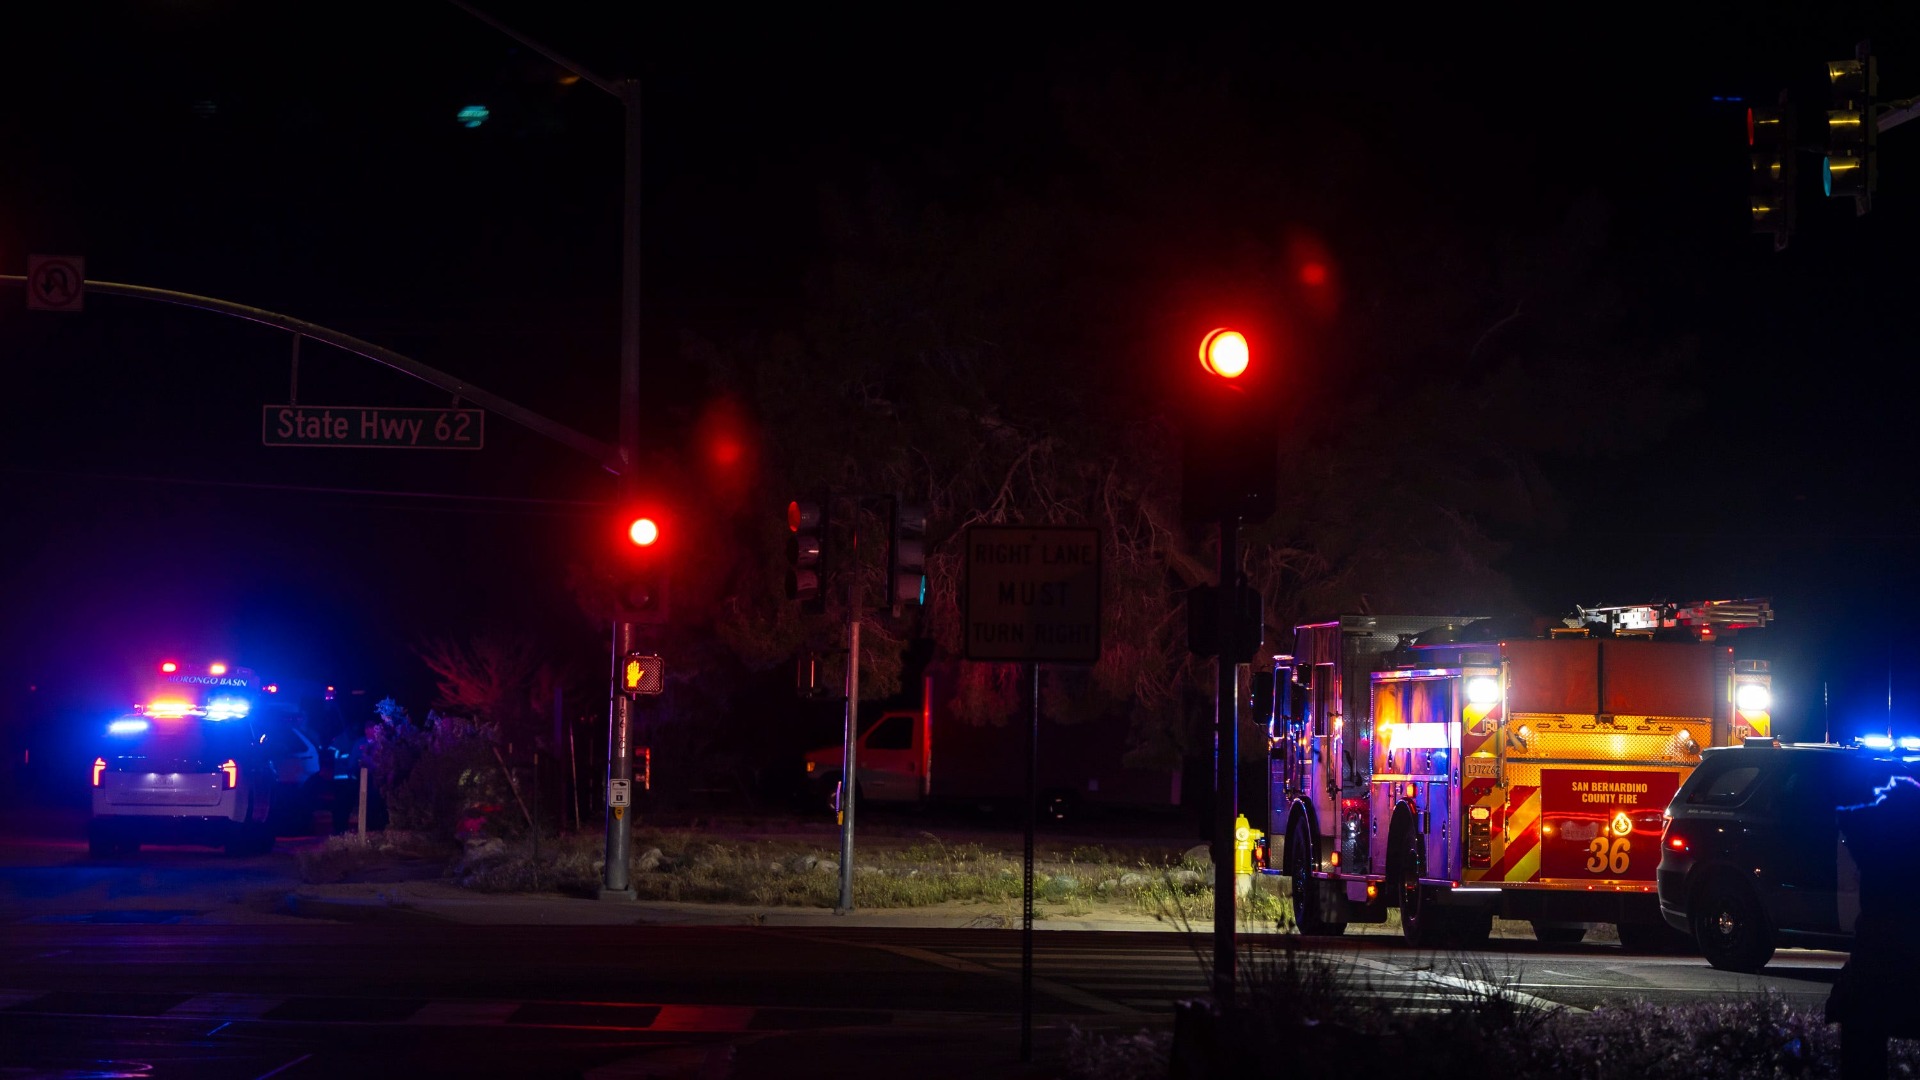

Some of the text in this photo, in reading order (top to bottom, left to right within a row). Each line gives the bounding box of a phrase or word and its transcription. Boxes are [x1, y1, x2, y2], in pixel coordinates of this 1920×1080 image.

[277, 408, 472, 445] State Hwy 62
[975, 544, 1092, 565] RIGHT LANE
[998, 581, 1069, 606] MUST
[973, 622, 1092, 644] TURN RIGHT
[168, 675, 248, 687] MORONGO BASIN
[1572, 781, 1648, 793] SAN BERNARDINO
[1582, 793, 1638, 804] COUNTY FIRE
[1587, 836, 1631, 874] 36
